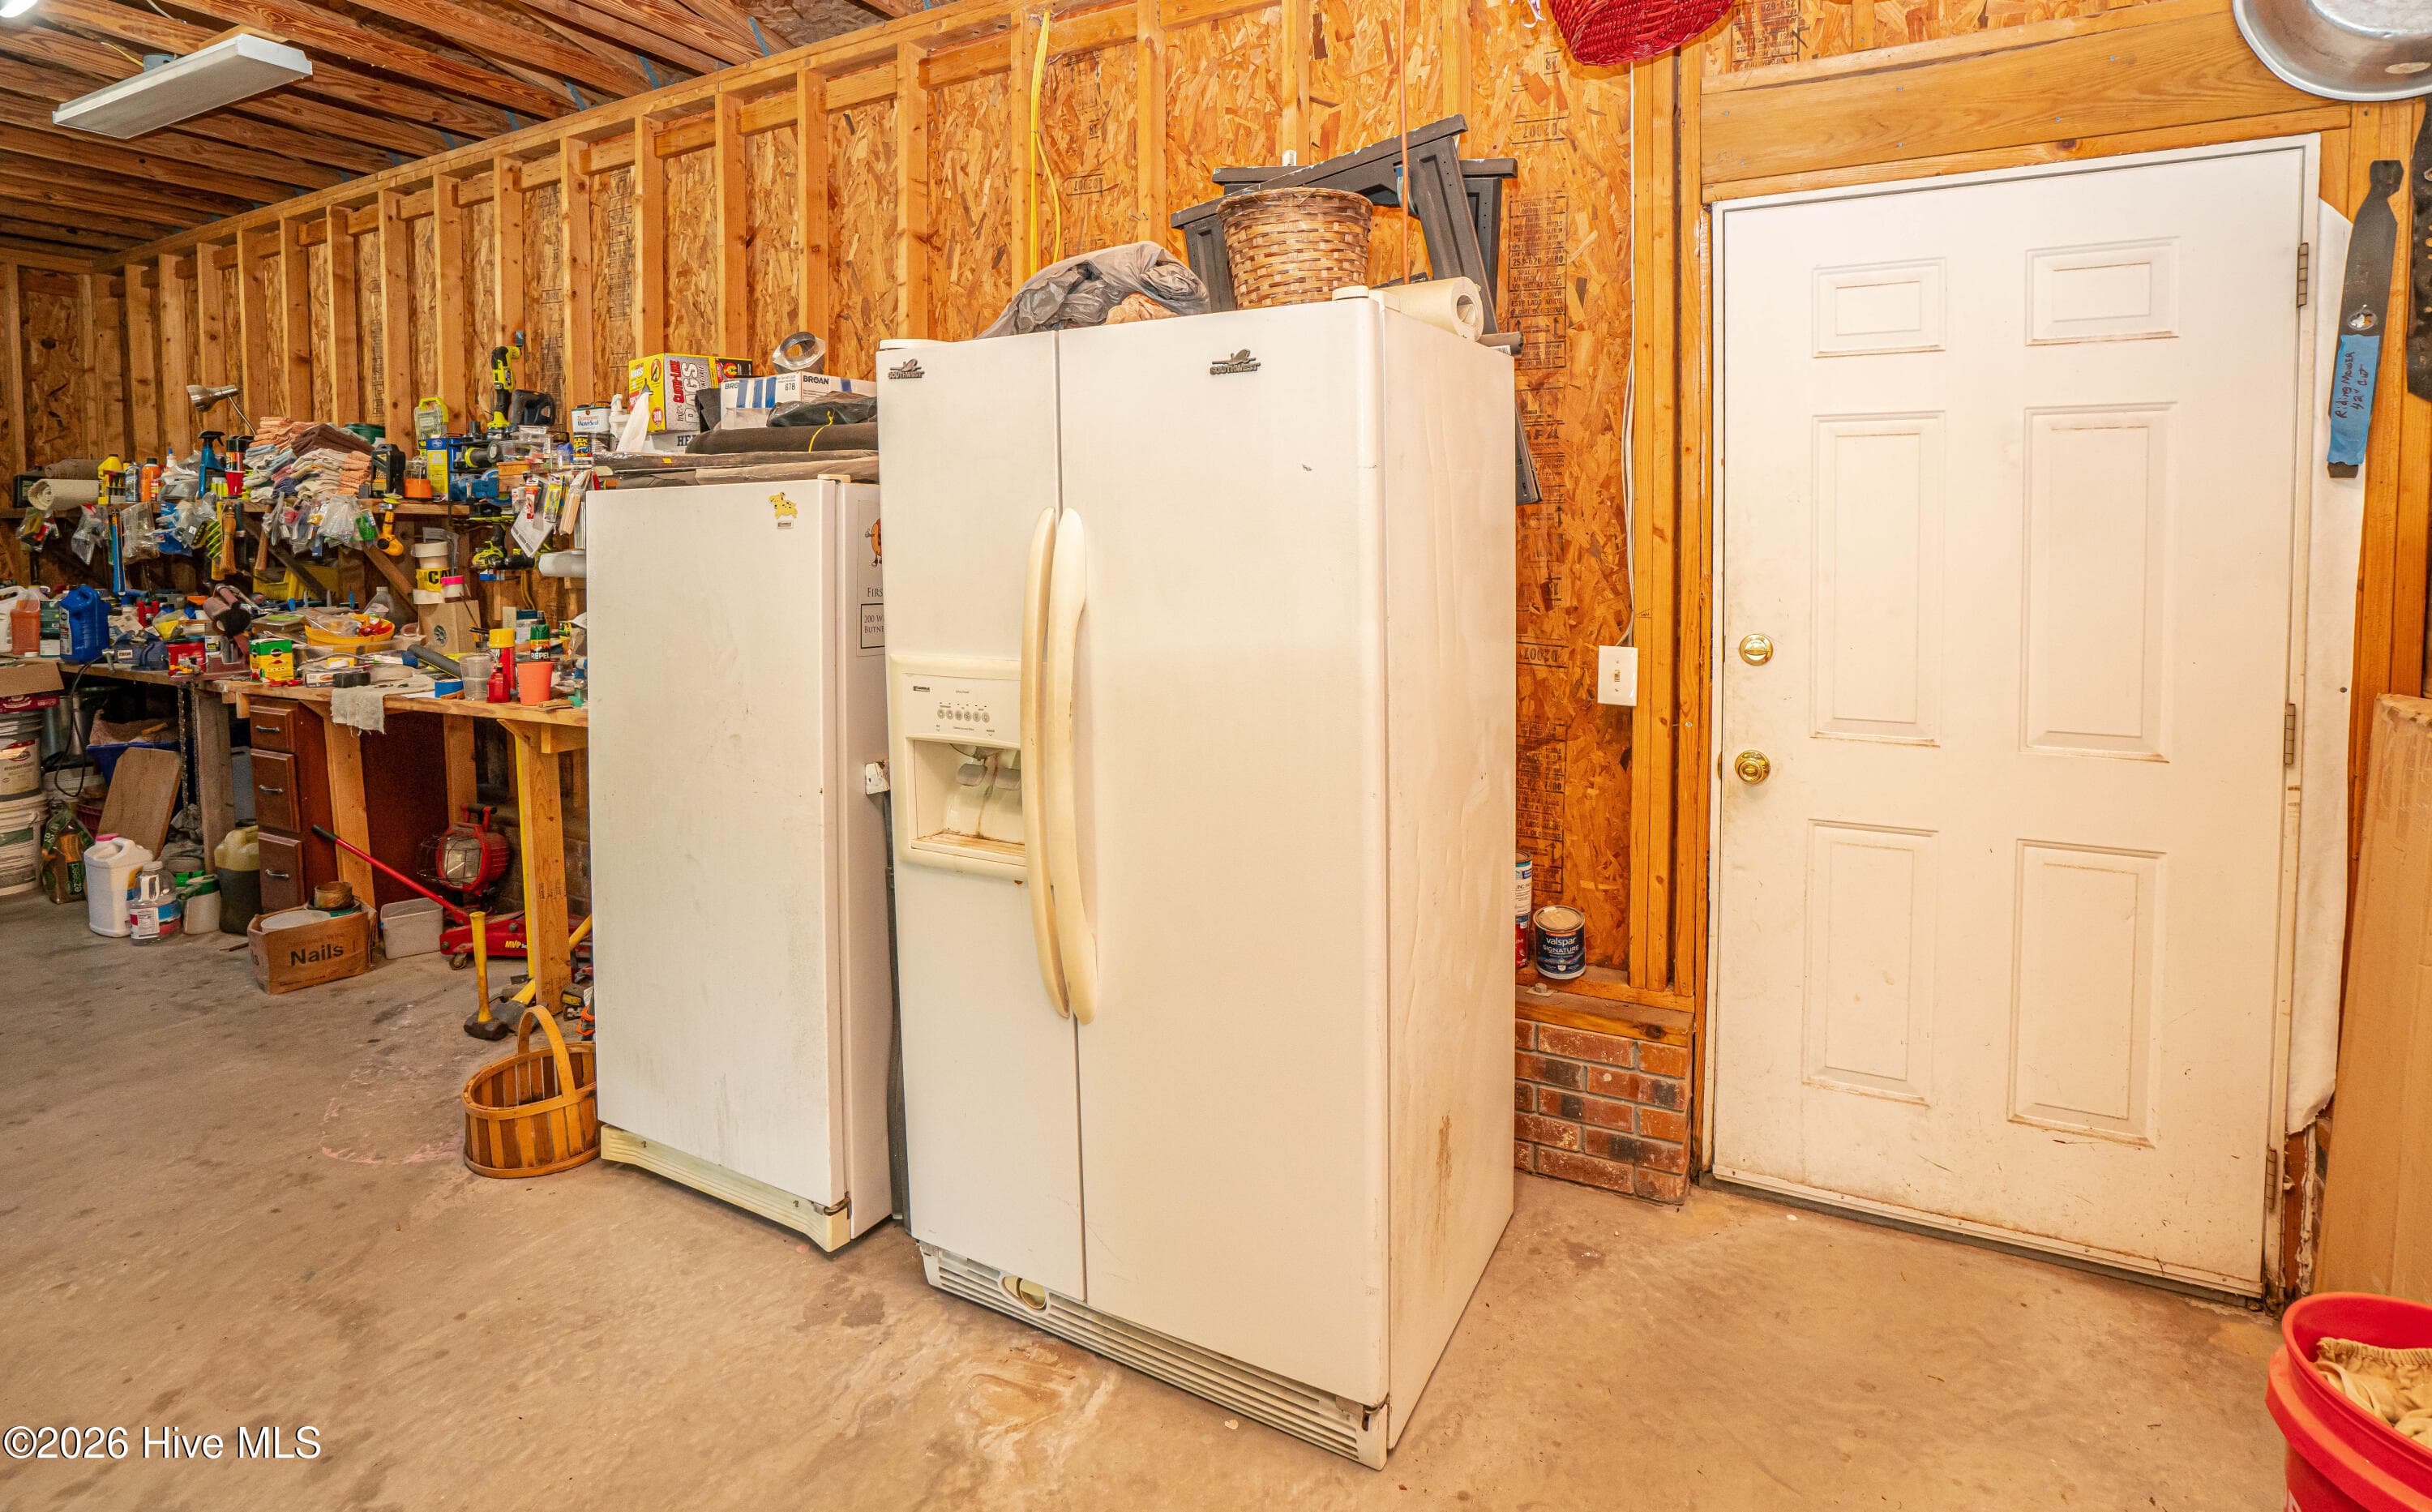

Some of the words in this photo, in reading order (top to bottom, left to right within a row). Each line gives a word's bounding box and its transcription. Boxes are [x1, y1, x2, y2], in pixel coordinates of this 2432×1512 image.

[1210, 362, 1258, 375] SOUTHWEST
[803, 375, 829, 386] BROAN
[680, 362, 700, 423] RAGS
[785, 382, 796, 392] 678
[2335, 387, 2352, 418] Riding
[863, 615, 875, 623] 200
[530, 652, 550, 660] REPEL
[504, 940, 522, 949] MVP
[1545, 936, 1577, 948] valspar
[290, 943, 345, 966] Nails
[1543, 944, 1580, 954] SIGNATURE
